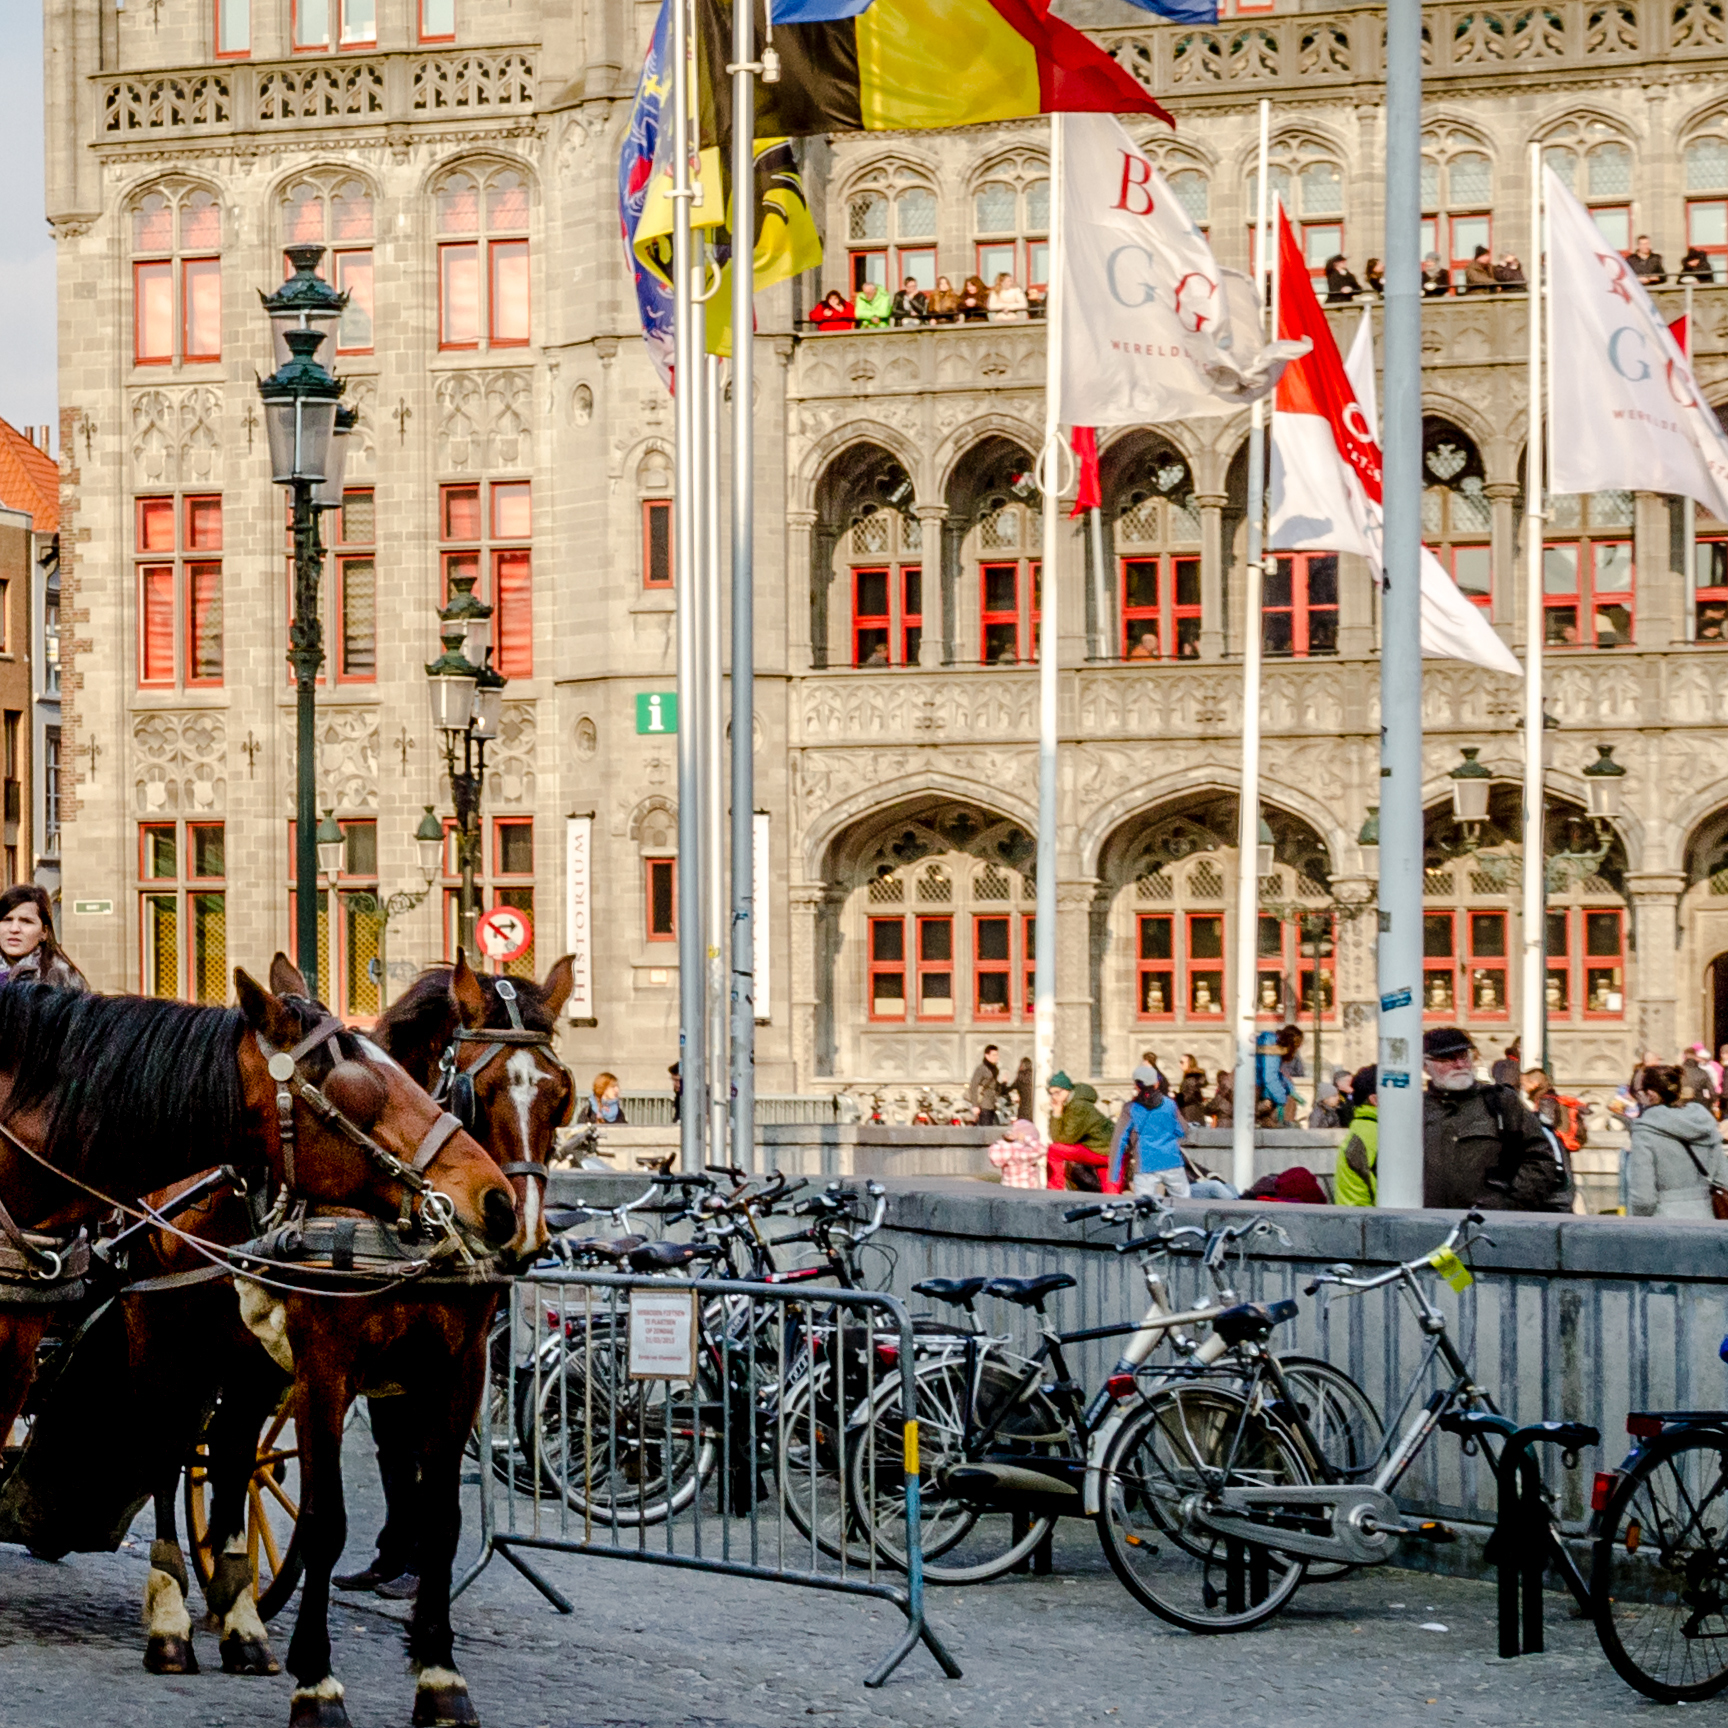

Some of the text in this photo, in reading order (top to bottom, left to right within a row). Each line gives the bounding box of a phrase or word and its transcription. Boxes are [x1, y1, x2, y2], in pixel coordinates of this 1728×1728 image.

[1110, 148, 1155, 216] B
[1106, 244, 1159, 308] G
[1608, 326, 1651, 382] G
[574, 833, 586, 1003] HISTORIUM
